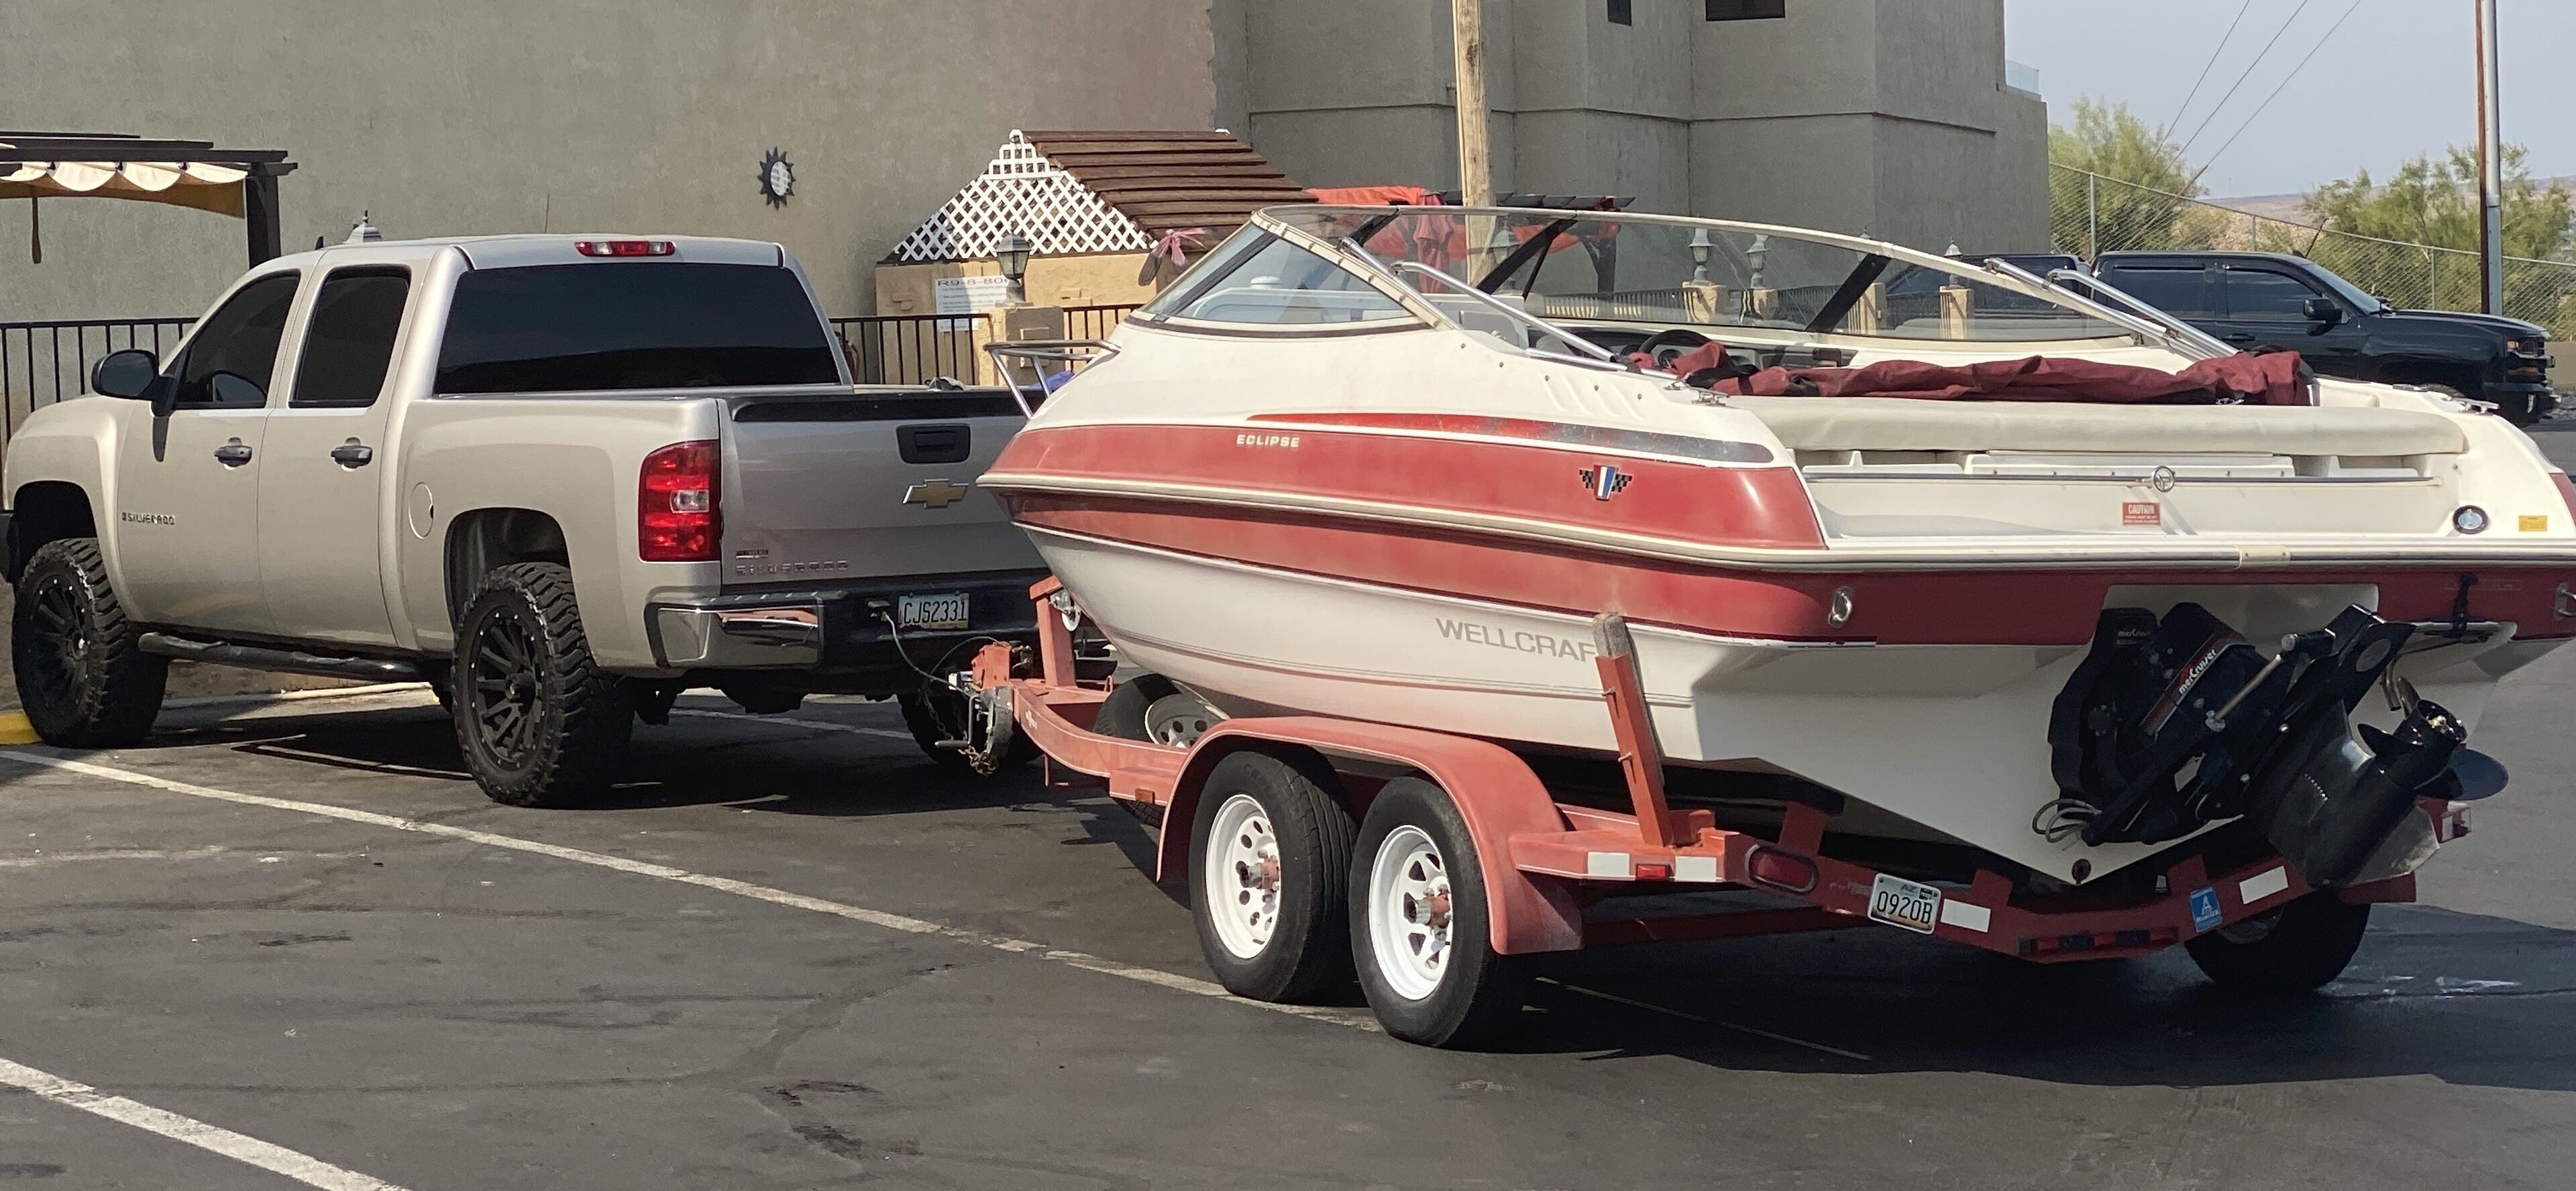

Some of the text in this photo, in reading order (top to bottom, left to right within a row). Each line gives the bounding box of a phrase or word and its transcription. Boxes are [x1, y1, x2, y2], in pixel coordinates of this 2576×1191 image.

[1236, 434, 1300, 448] ECLIPSE
[2128, 504, 2155, 515] CAUTION
[904, 600, 967, 624] CJS2331
[1434, 617, 1597, 663] WELLCRAF
[1877, 891, 1932, 924] 0920B
